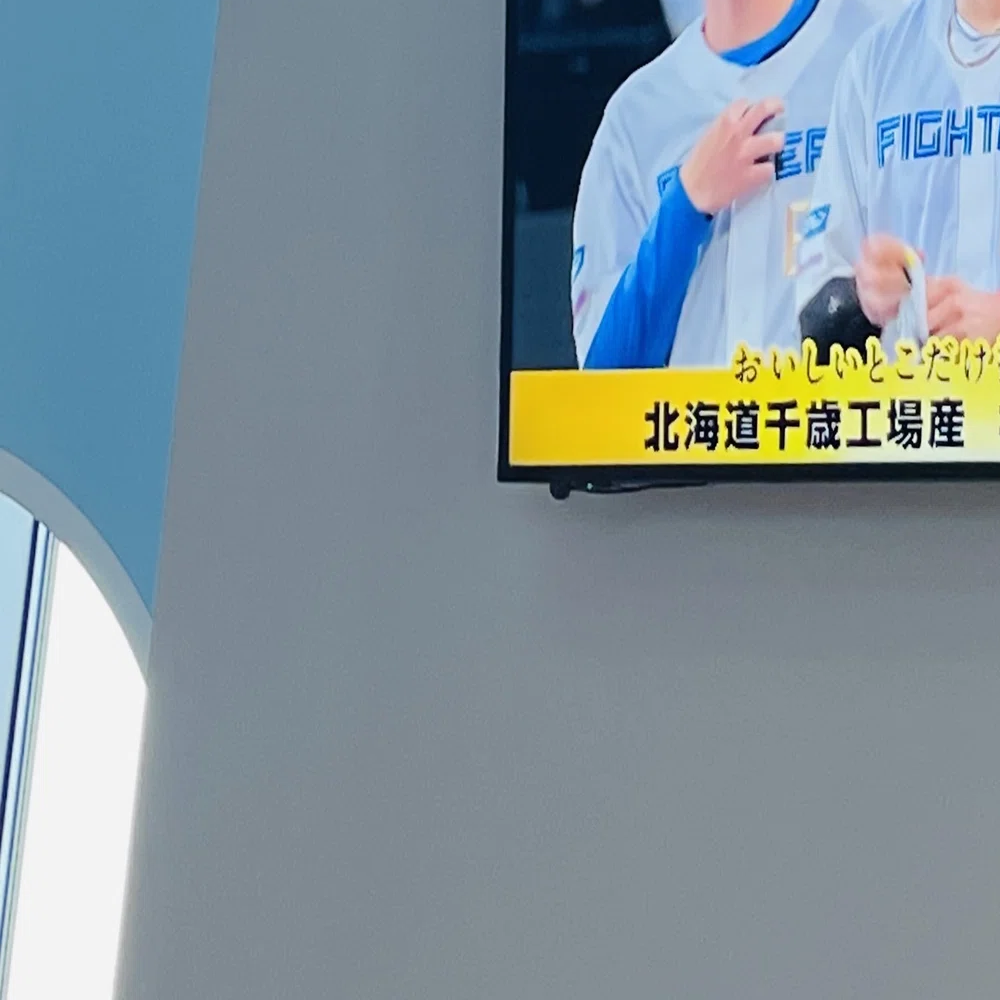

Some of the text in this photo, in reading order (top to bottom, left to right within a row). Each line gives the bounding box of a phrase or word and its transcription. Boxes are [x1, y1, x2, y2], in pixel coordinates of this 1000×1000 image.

[643, 398, 966, 452] 北海道千歳工場産
